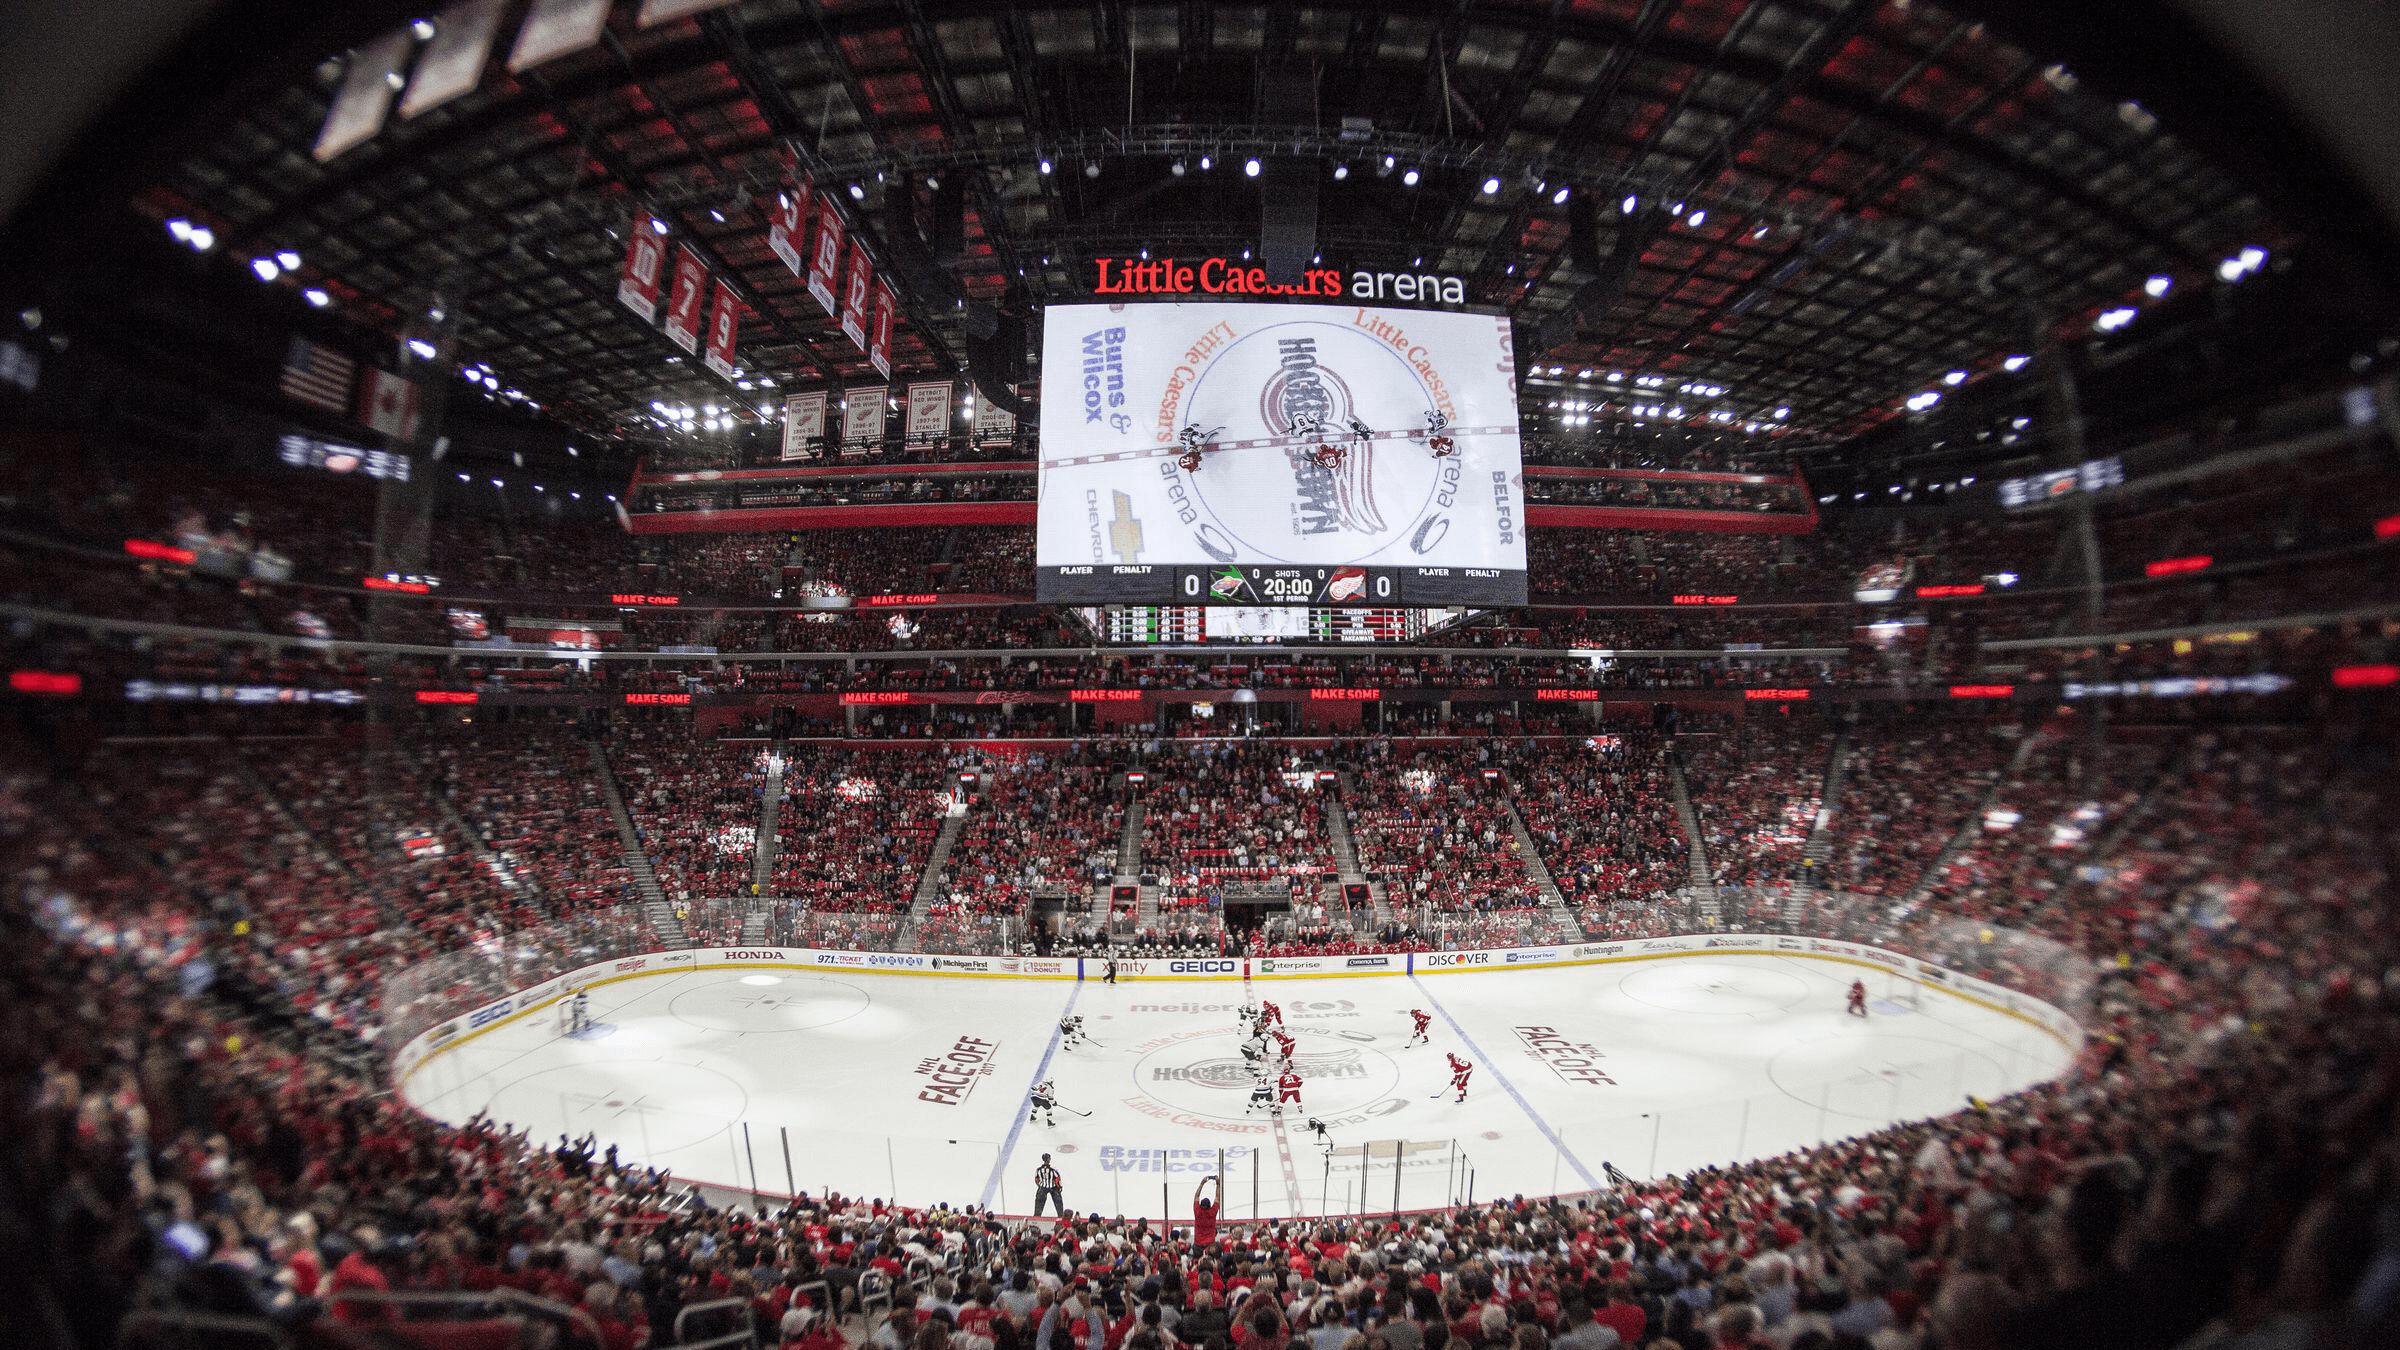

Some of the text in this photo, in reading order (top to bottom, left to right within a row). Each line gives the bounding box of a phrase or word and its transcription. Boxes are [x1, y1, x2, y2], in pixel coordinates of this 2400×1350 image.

[1095, 257, 1194, 293] Little
[1351, 268, 1464, 304] arena
[1353, 306, 1457, 421] Little Caesars
[1082, 331, 1103, 424] Wilcox
[1105, 327, 1131, 434] Burns &
[1156, 320, 1237, 443] Little Caesars
[1436, 443, 1462, 508] arena
[1160, 461, 1198, 525] arena
[1492, 470, 1514, 545] BELFOR
[1060, 565, 1152, 575] PLAYER PENALTY
[1252, 568, 1260, 579] 0
[1317, 568, 1325, 579] 0
[1418, 568, 1501, 578] PLAYER PENALTY
[1184, 574, 1200, 596] 0
[1264, 578, 1313, 595] 20:00
[1376, 576, 1390, 597] 0
[845, 692, 909, 703] MAKE SOME
[1071, 690, 1142, 700] MAKE SOME
[1311, 689, 1380, 700] MAKE SOME
[1537, 689, 1599, 700] MAKE SOME
[725, 951, 785, 960] HONDA
[1584, 945, 1623, 955] Huntington
[943, 959, 972, 968] Michigan
[1103, 961, 1148, 974] xinity
[1170, 961, 1235, 973] GEICO
[1130, 1002, 1235, 1014] meijer
[1515, 1026, 1618, 1086] FACE-OFF
[1575, 1043, 1606, 1059] NHL
[914, 1057, 941, 1075] NHL
[918, 1035, 993, 1105] FACE-OFF
[1171, 1113, 1268, 1134] Caesars
[1291, 1115, 1367, 1133] aena
[1100, 1145, 1257, 1159] Burns &
[1100, 1158, 1235, 1173] Wilcox
